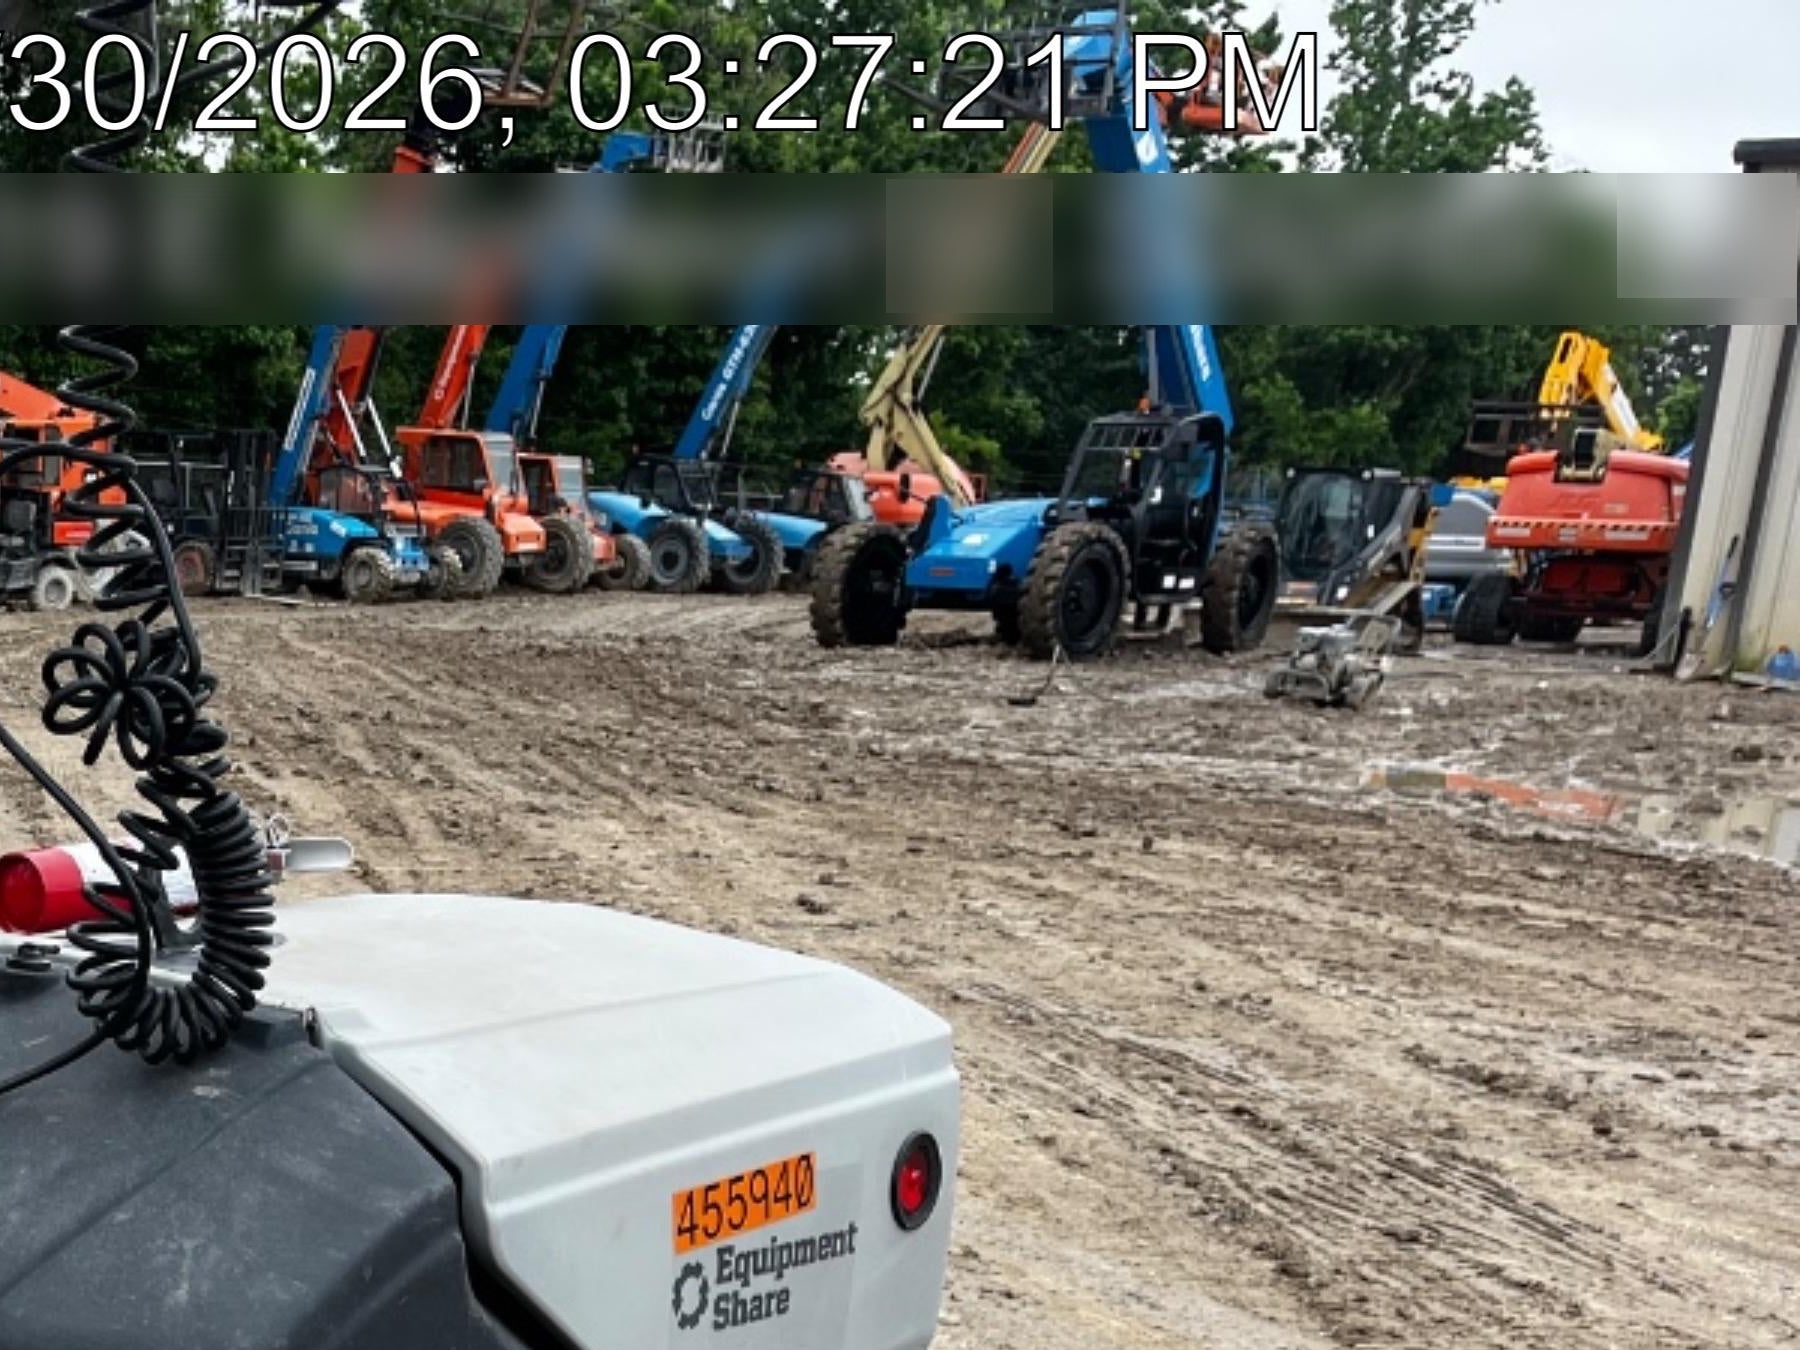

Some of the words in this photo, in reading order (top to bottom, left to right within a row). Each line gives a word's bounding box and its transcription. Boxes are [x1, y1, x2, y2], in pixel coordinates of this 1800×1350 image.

[677, 1154, 814, 1246] 455940
[715, 1221, 858, 1288] Equipment
[712, 1286, 790, 1331] Share
